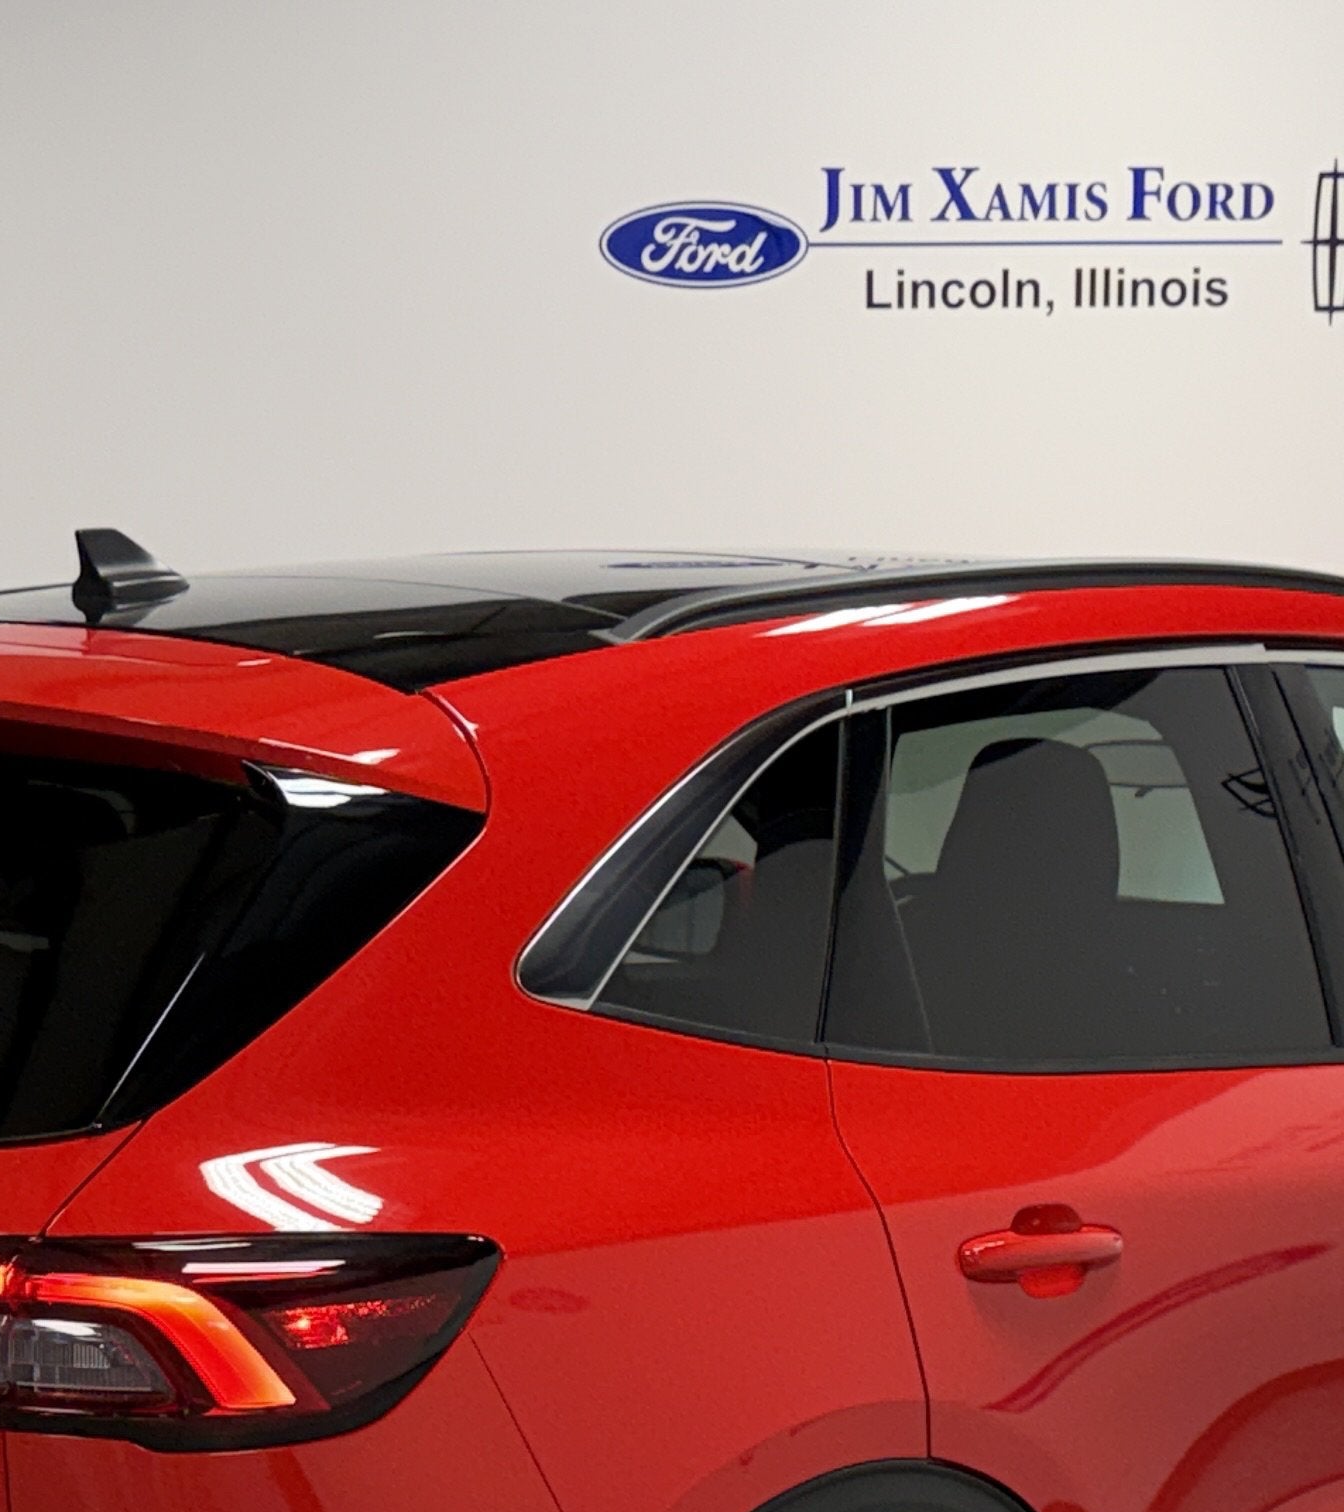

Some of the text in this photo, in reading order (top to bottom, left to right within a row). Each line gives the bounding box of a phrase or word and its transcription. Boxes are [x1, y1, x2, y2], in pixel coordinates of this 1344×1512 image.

[820, 167, 1275, 233] JIM XAMIS FORD
[641, 215, 764, 275] Ford
[865, 267, 1229, 313] Lincoln, Illinois
